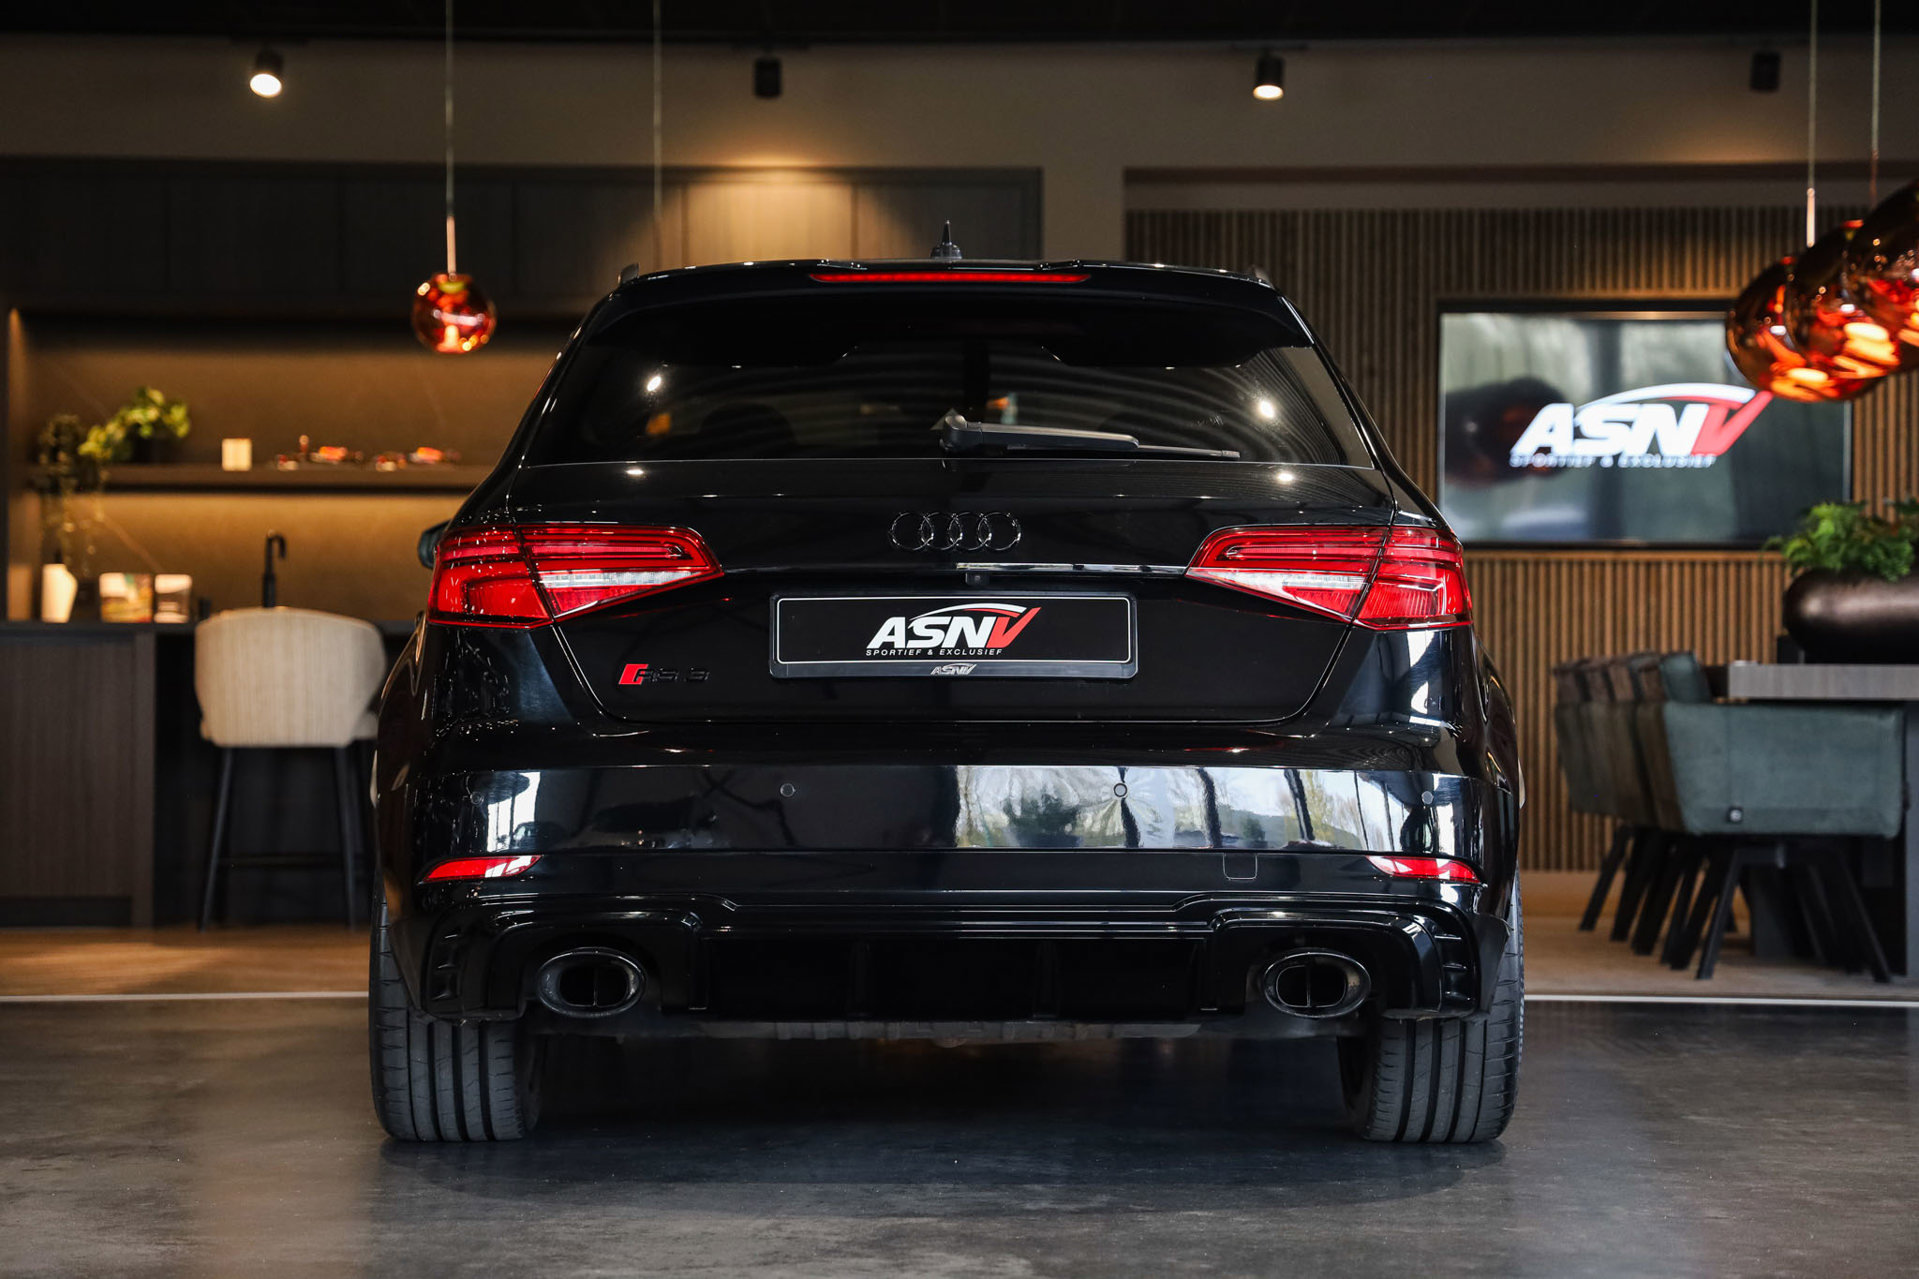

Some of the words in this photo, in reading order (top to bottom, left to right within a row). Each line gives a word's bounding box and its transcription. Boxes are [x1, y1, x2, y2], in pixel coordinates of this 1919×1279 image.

[1509, 387, 1774, 456] ASNV
[866, 606, 1042, 649] ASNV
[865, 648, 922, 656] SPORTIEF
[926, 648, 934, 656] &
[939, 648, 1003, 656] EXCLUSIEF
